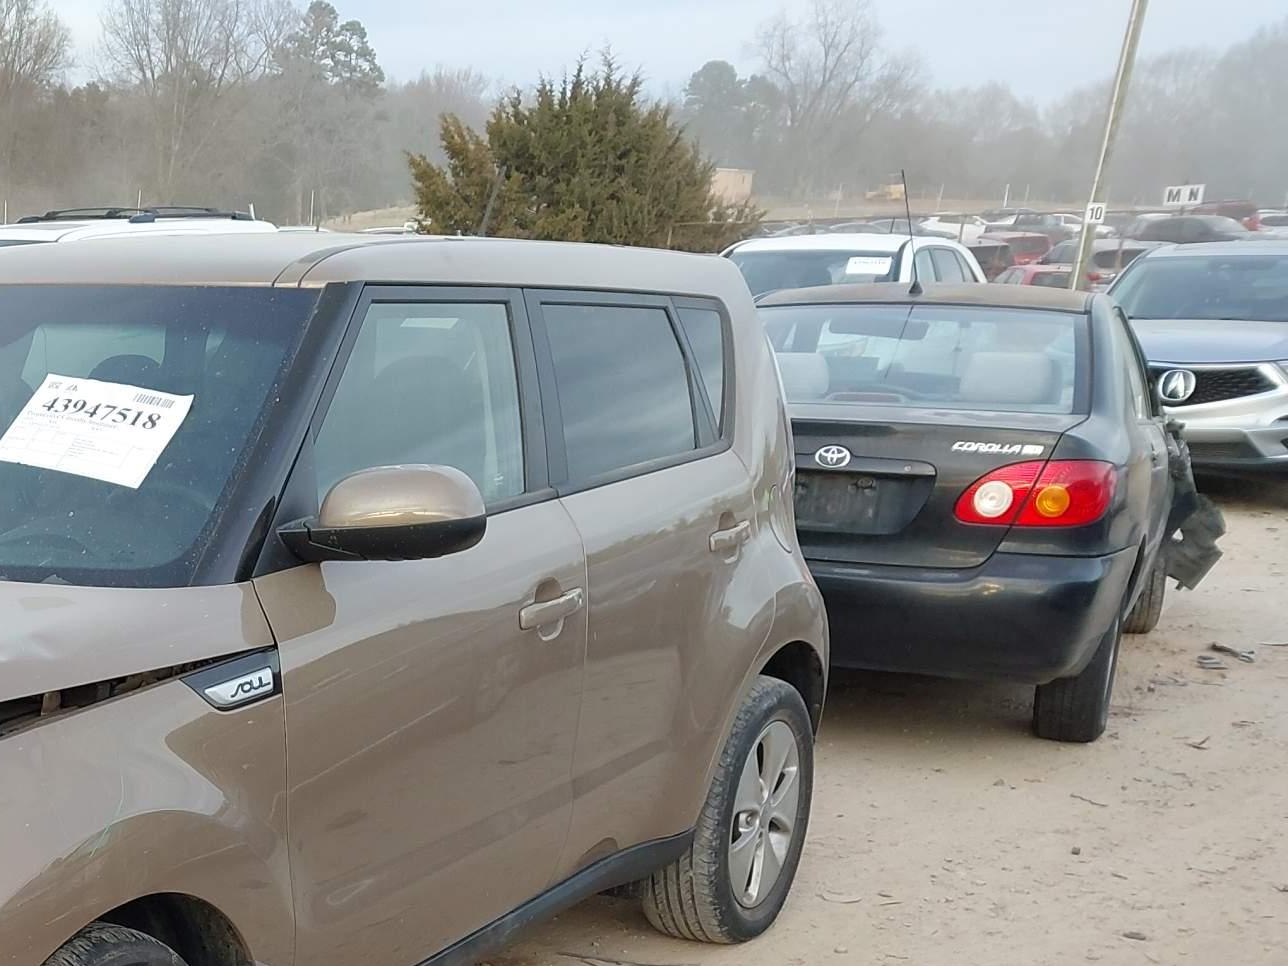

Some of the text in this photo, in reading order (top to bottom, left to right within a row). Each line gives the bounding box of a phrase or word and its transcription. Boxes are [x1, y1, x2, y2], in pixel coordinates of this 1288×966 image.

[1167, 186, 1201, 203] M N
[1088, 206, 1103, 220] 10
[42, 396, 162, 430] 43947518
[952, 441, 1022, 456] COROLLA
